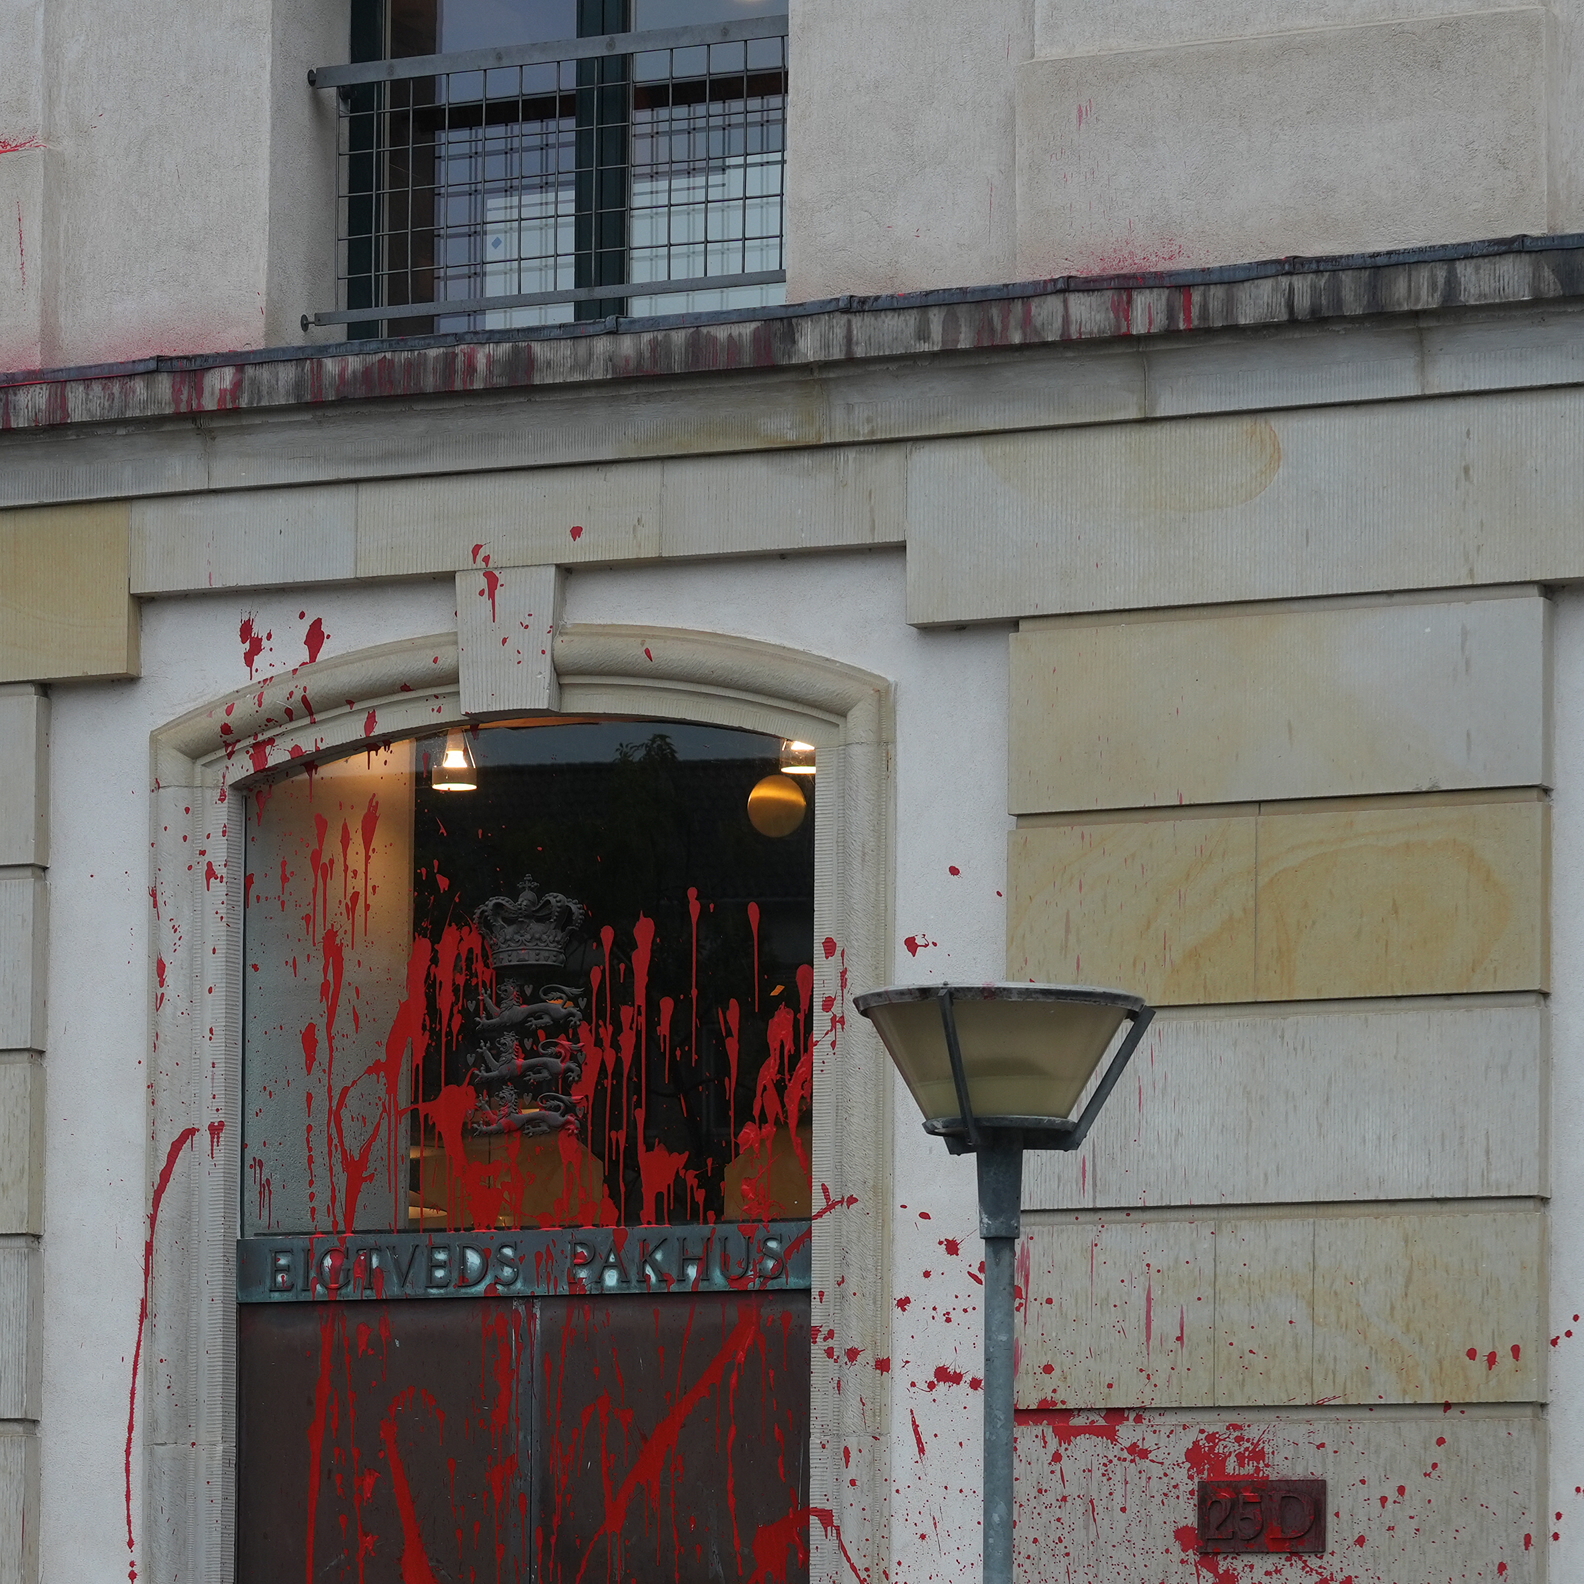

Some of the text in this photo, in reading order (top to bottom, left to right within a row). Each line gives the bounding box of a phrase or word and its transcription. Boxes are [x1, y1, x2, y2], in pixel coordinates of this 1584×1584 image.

[267, 1234, 786, 1293] EIGTVEDS PAKHUS
[1204, 1490, 1317, 1541] 25D
